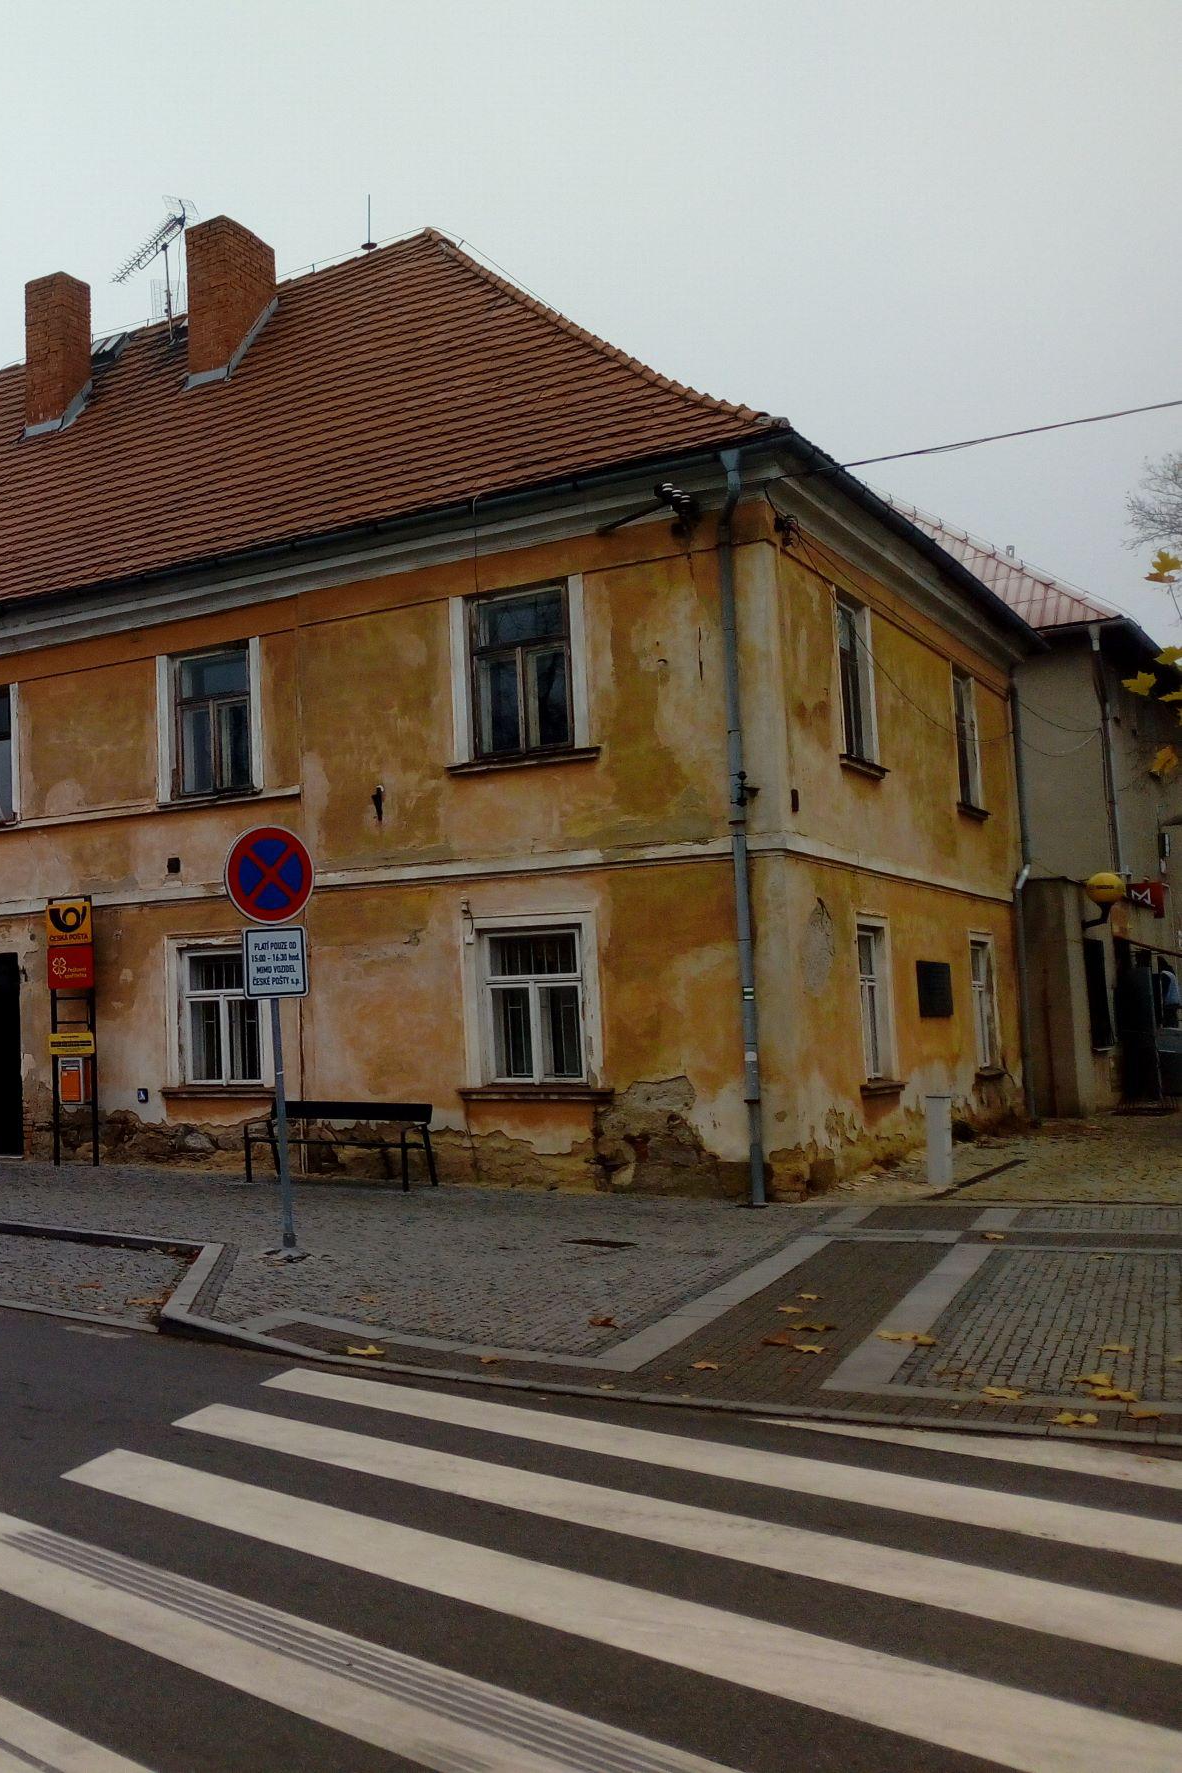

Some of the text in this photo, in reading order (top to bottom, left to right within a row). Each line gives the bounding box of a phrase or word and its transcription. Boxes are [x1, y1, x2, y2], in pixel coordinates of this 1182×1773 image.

[49, 934, 68, 942] ČESKÁ
[254, 941, 297, 951] PLATÍ POUZE OD
[256, 964, 296, 974] MIMO VOZIDEL
[252, 976, 270, 986] ČESKÉ
[271, 975, 289, 985] POŠTY
